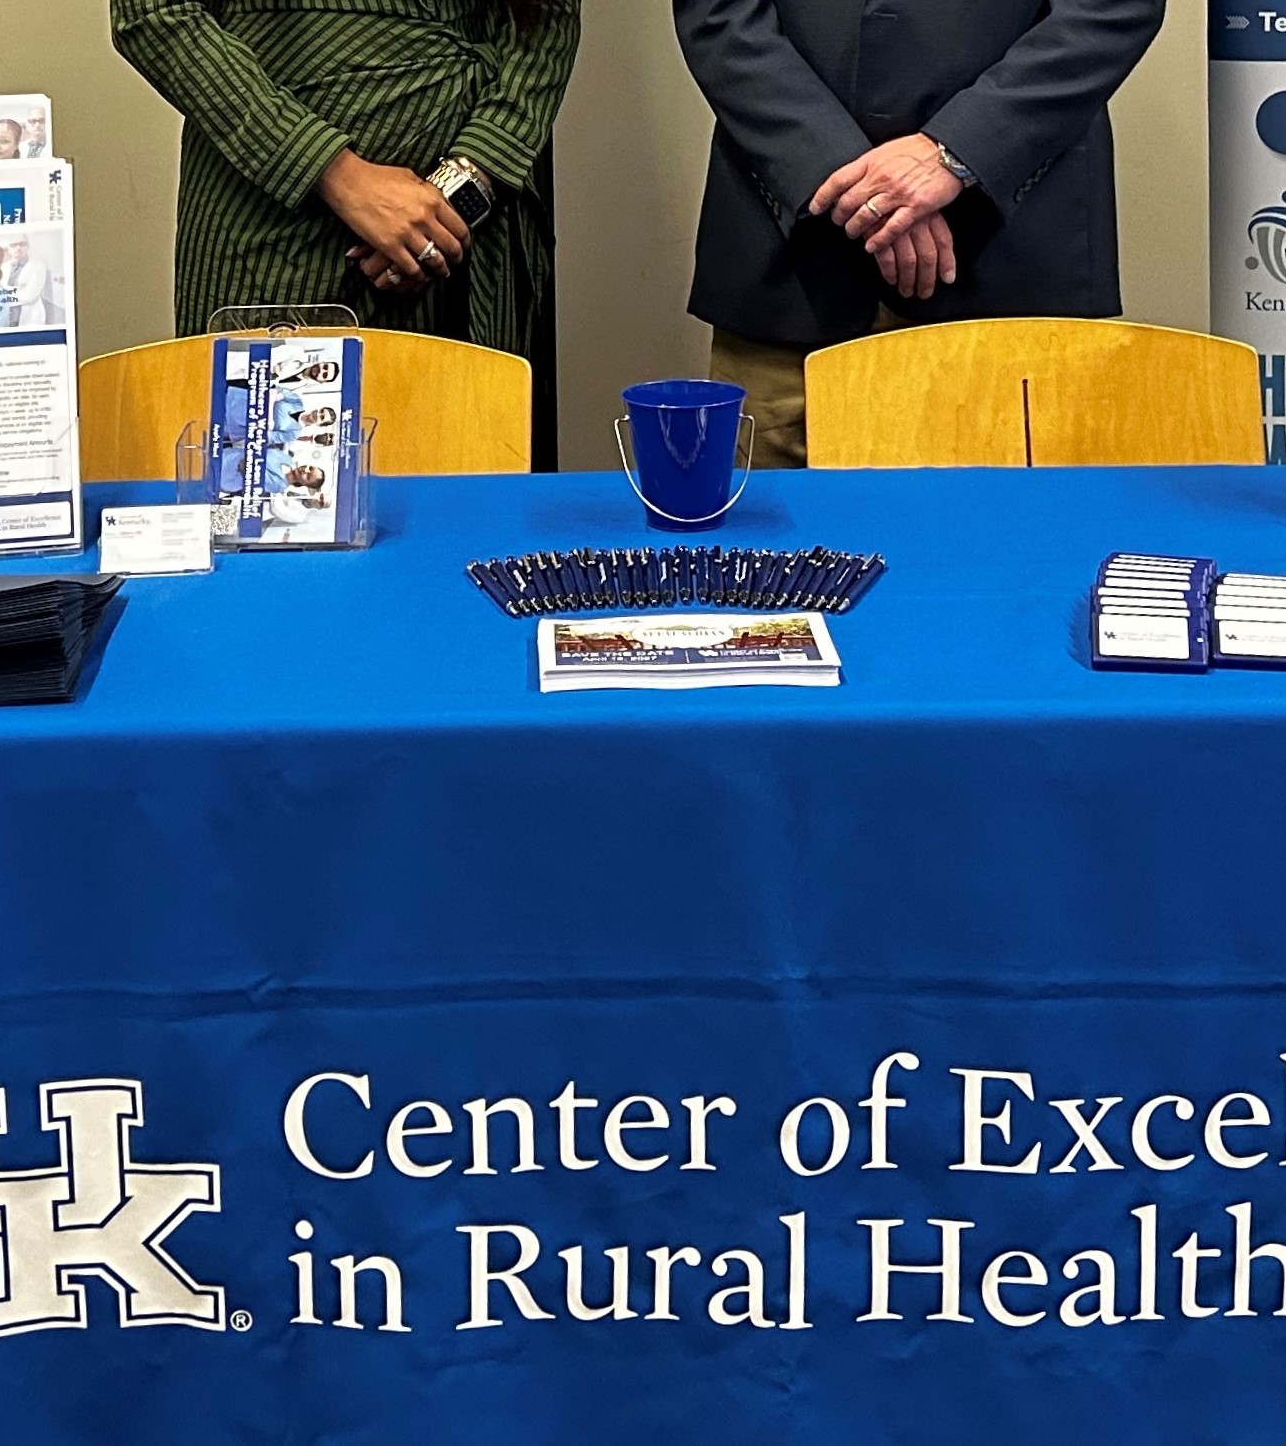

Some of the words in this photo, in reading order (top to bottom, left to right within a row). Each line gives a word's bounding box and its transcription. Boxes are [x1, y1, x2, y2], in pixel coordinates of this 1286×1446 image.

[248, 362, 258, 405] Program
[258, 359, 268, 415] Healthcare
[247, 423, 257, 438] the
[248, 408, 257, 420] of
[255, 418, 267, 455] Worker
[242, 442, 255, 518] Commonwealth
[253, 459, 263, 484] Loan
[252, 488, 262, 517] Relief
[284, 1073, 736, 1179] Center
[781, 1053, 919, 1176] of
[288, 1220, 411, 1332] in
[456, 1212, 813, 1329] Rural
